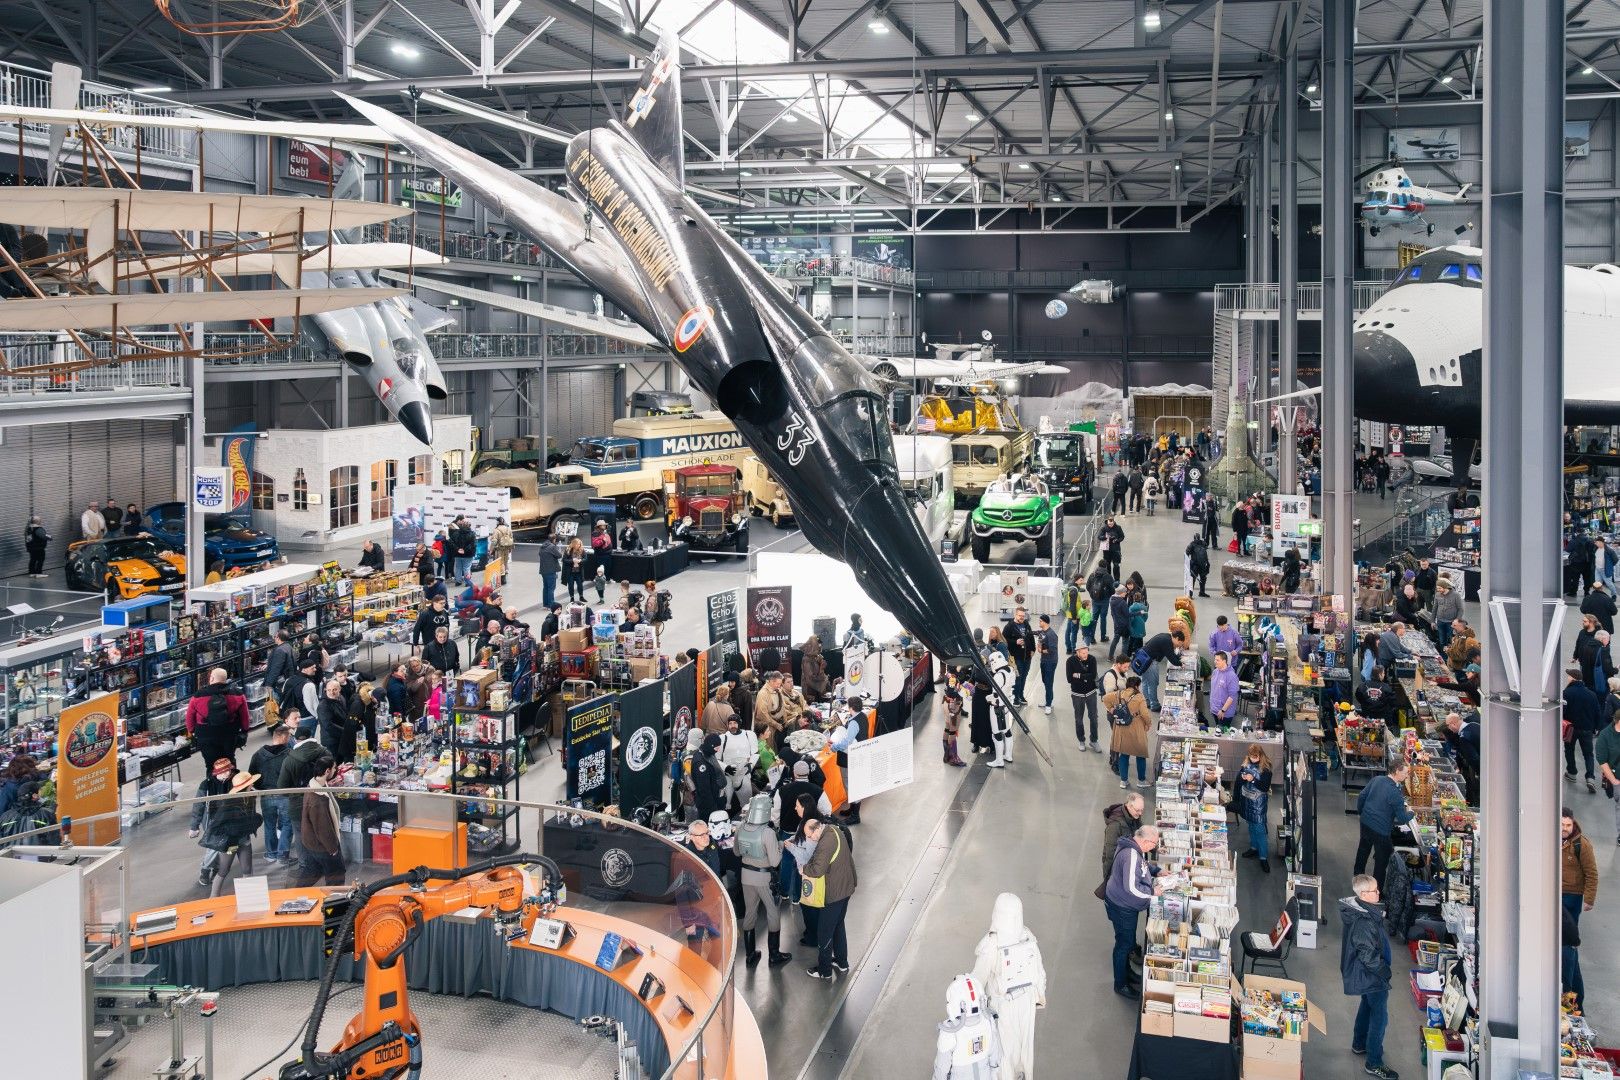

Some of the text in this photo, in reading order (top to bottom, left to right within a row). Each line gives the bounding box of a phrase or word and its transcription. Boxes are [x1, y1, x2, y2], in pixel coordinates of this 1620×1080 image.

[291, 140, 309, 152] Mus
[290, 155, 309, 166] eum
[604, 189, 629, 219] DE
[613, 201, 681, 293] RECONNAISSANCE
[662, 432, 743, 455] MAUXION
[777, 411, 817, 466] 33
[711, 594, 732, 609] Echo
[711, 608, 731, 620] Echo
[574, 707, 610, 731] JEDIPEDIA
[85, 744, 93, 753] OF
[73, 767, 109, 786] SPIELZEUG
[91, 776, 105, 786] UND
[74, 783, 106, 800] VERKAUF
[375, 1043, 403, 1065] KUKA
